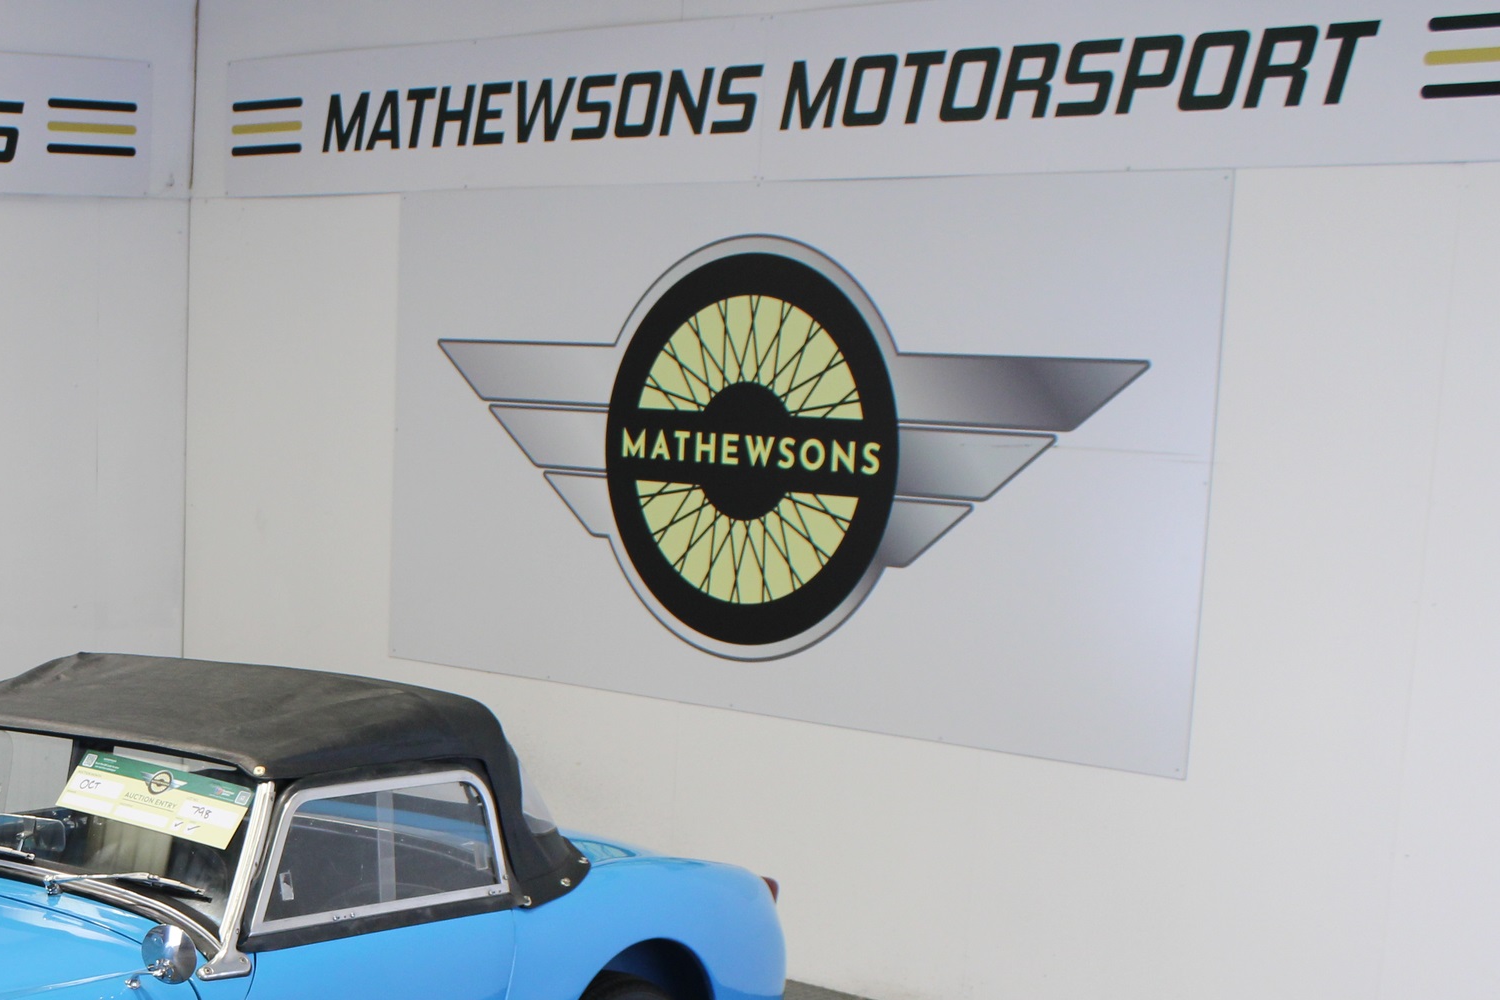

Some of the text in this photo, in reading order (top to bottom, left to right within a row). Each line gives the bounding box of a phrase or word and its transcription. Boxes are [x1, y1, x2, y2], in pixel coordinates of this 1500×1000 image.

[321, 19, 1382, 153] MATHEWSONS MOTORSPORT
[622, 428, 881, 475] MATHEWSONS
[79, 779, 102, 790] OCT
[125, 791, 154, 804] AUCTION
[155, 799, 177, 810] ENTRY
[192, 805, 212, 819] 798
